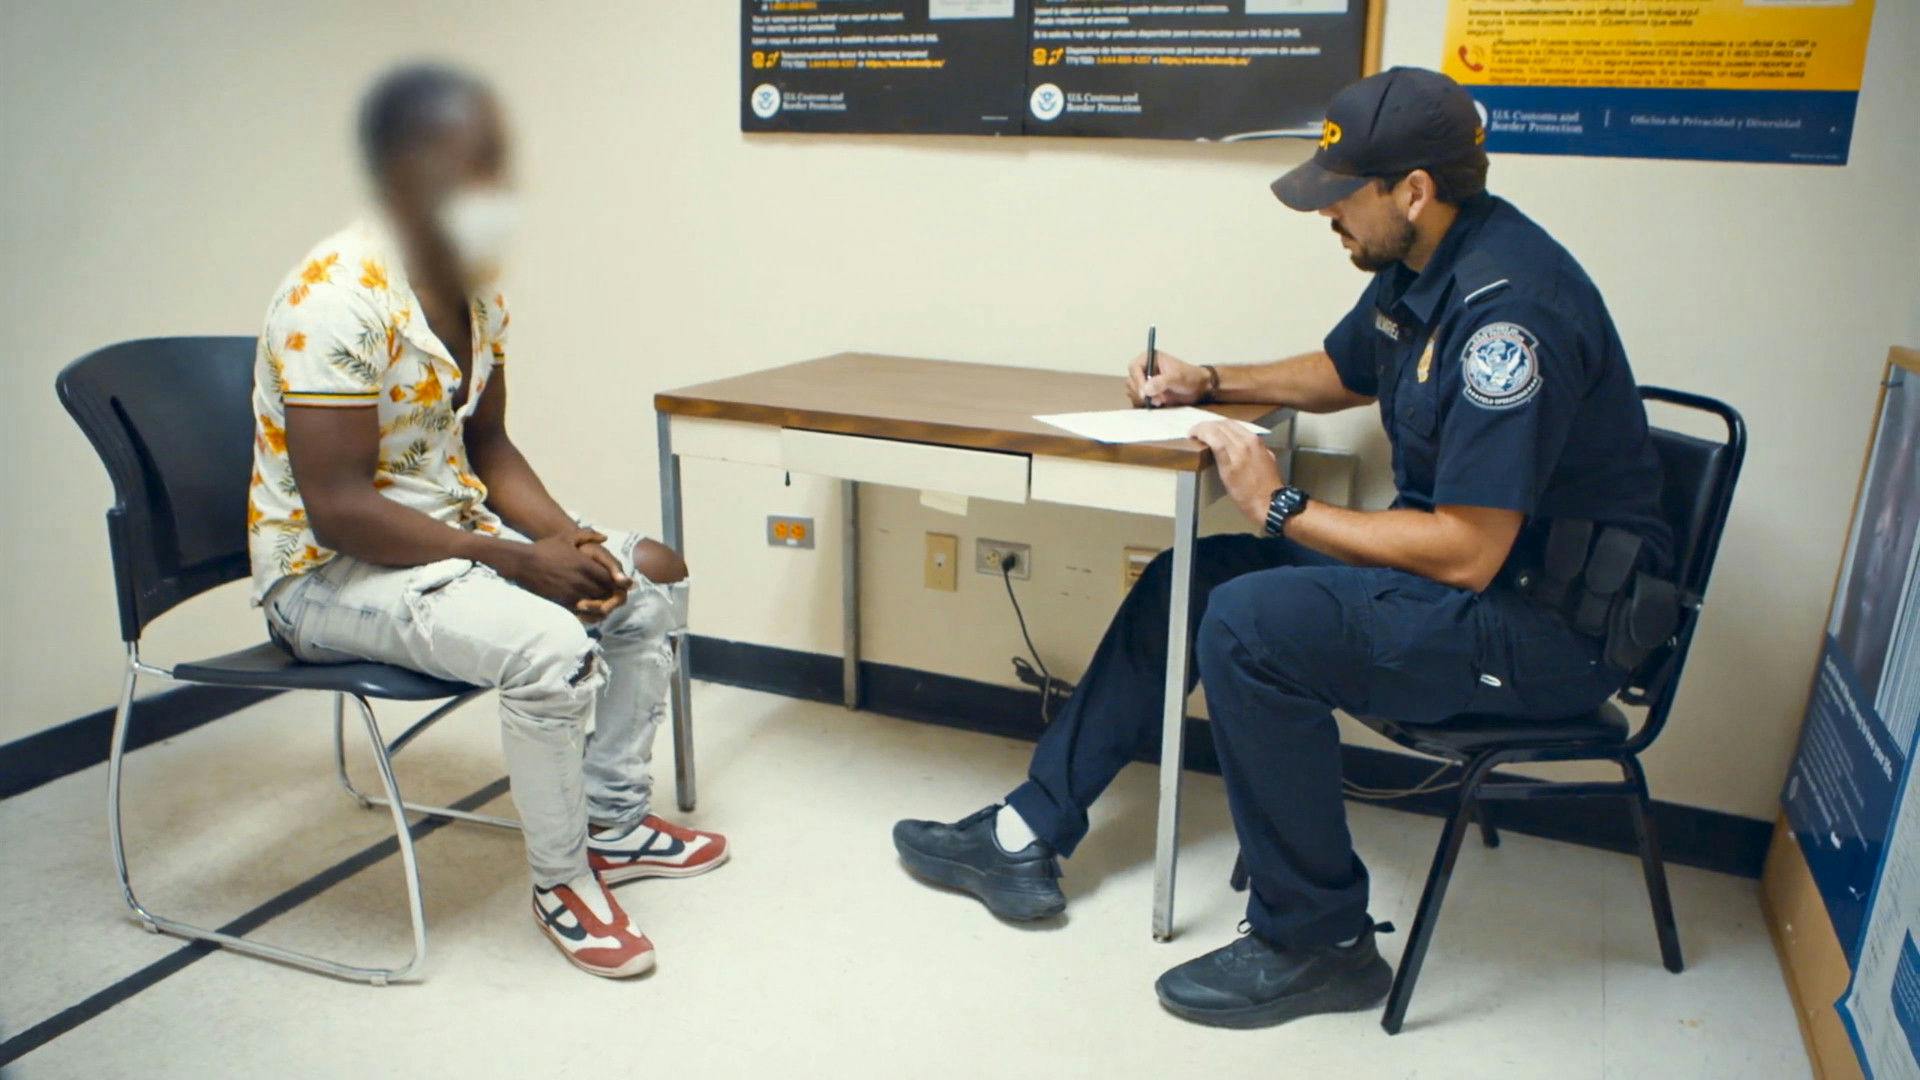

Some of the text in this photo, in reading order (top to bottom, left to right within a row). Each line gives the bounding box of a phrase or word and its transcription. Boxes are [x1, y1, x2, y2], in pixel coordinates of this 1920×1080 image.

[798, 92, 829, 101] Customs
[830, 92, 844, 101] and
[1084, 92, 1120, 102] Customs
[1122, 93, 1138, 102] and
[782, 102, 847, 111] Border Protection
[1067, 103, 1142, 112] Border Protection
[1512, 110, 1557, 121] Customs
[1559, 112, 1579, 122] and
[1491, 121, 1583, 133] Border Protection
[1630, 115, 1666, 125] Oficina
[1668, 116, 1680, 125] de
[1682, 116, 1735, 127] Privacidad
[1746, 118, 1801, 129] Diversidad
